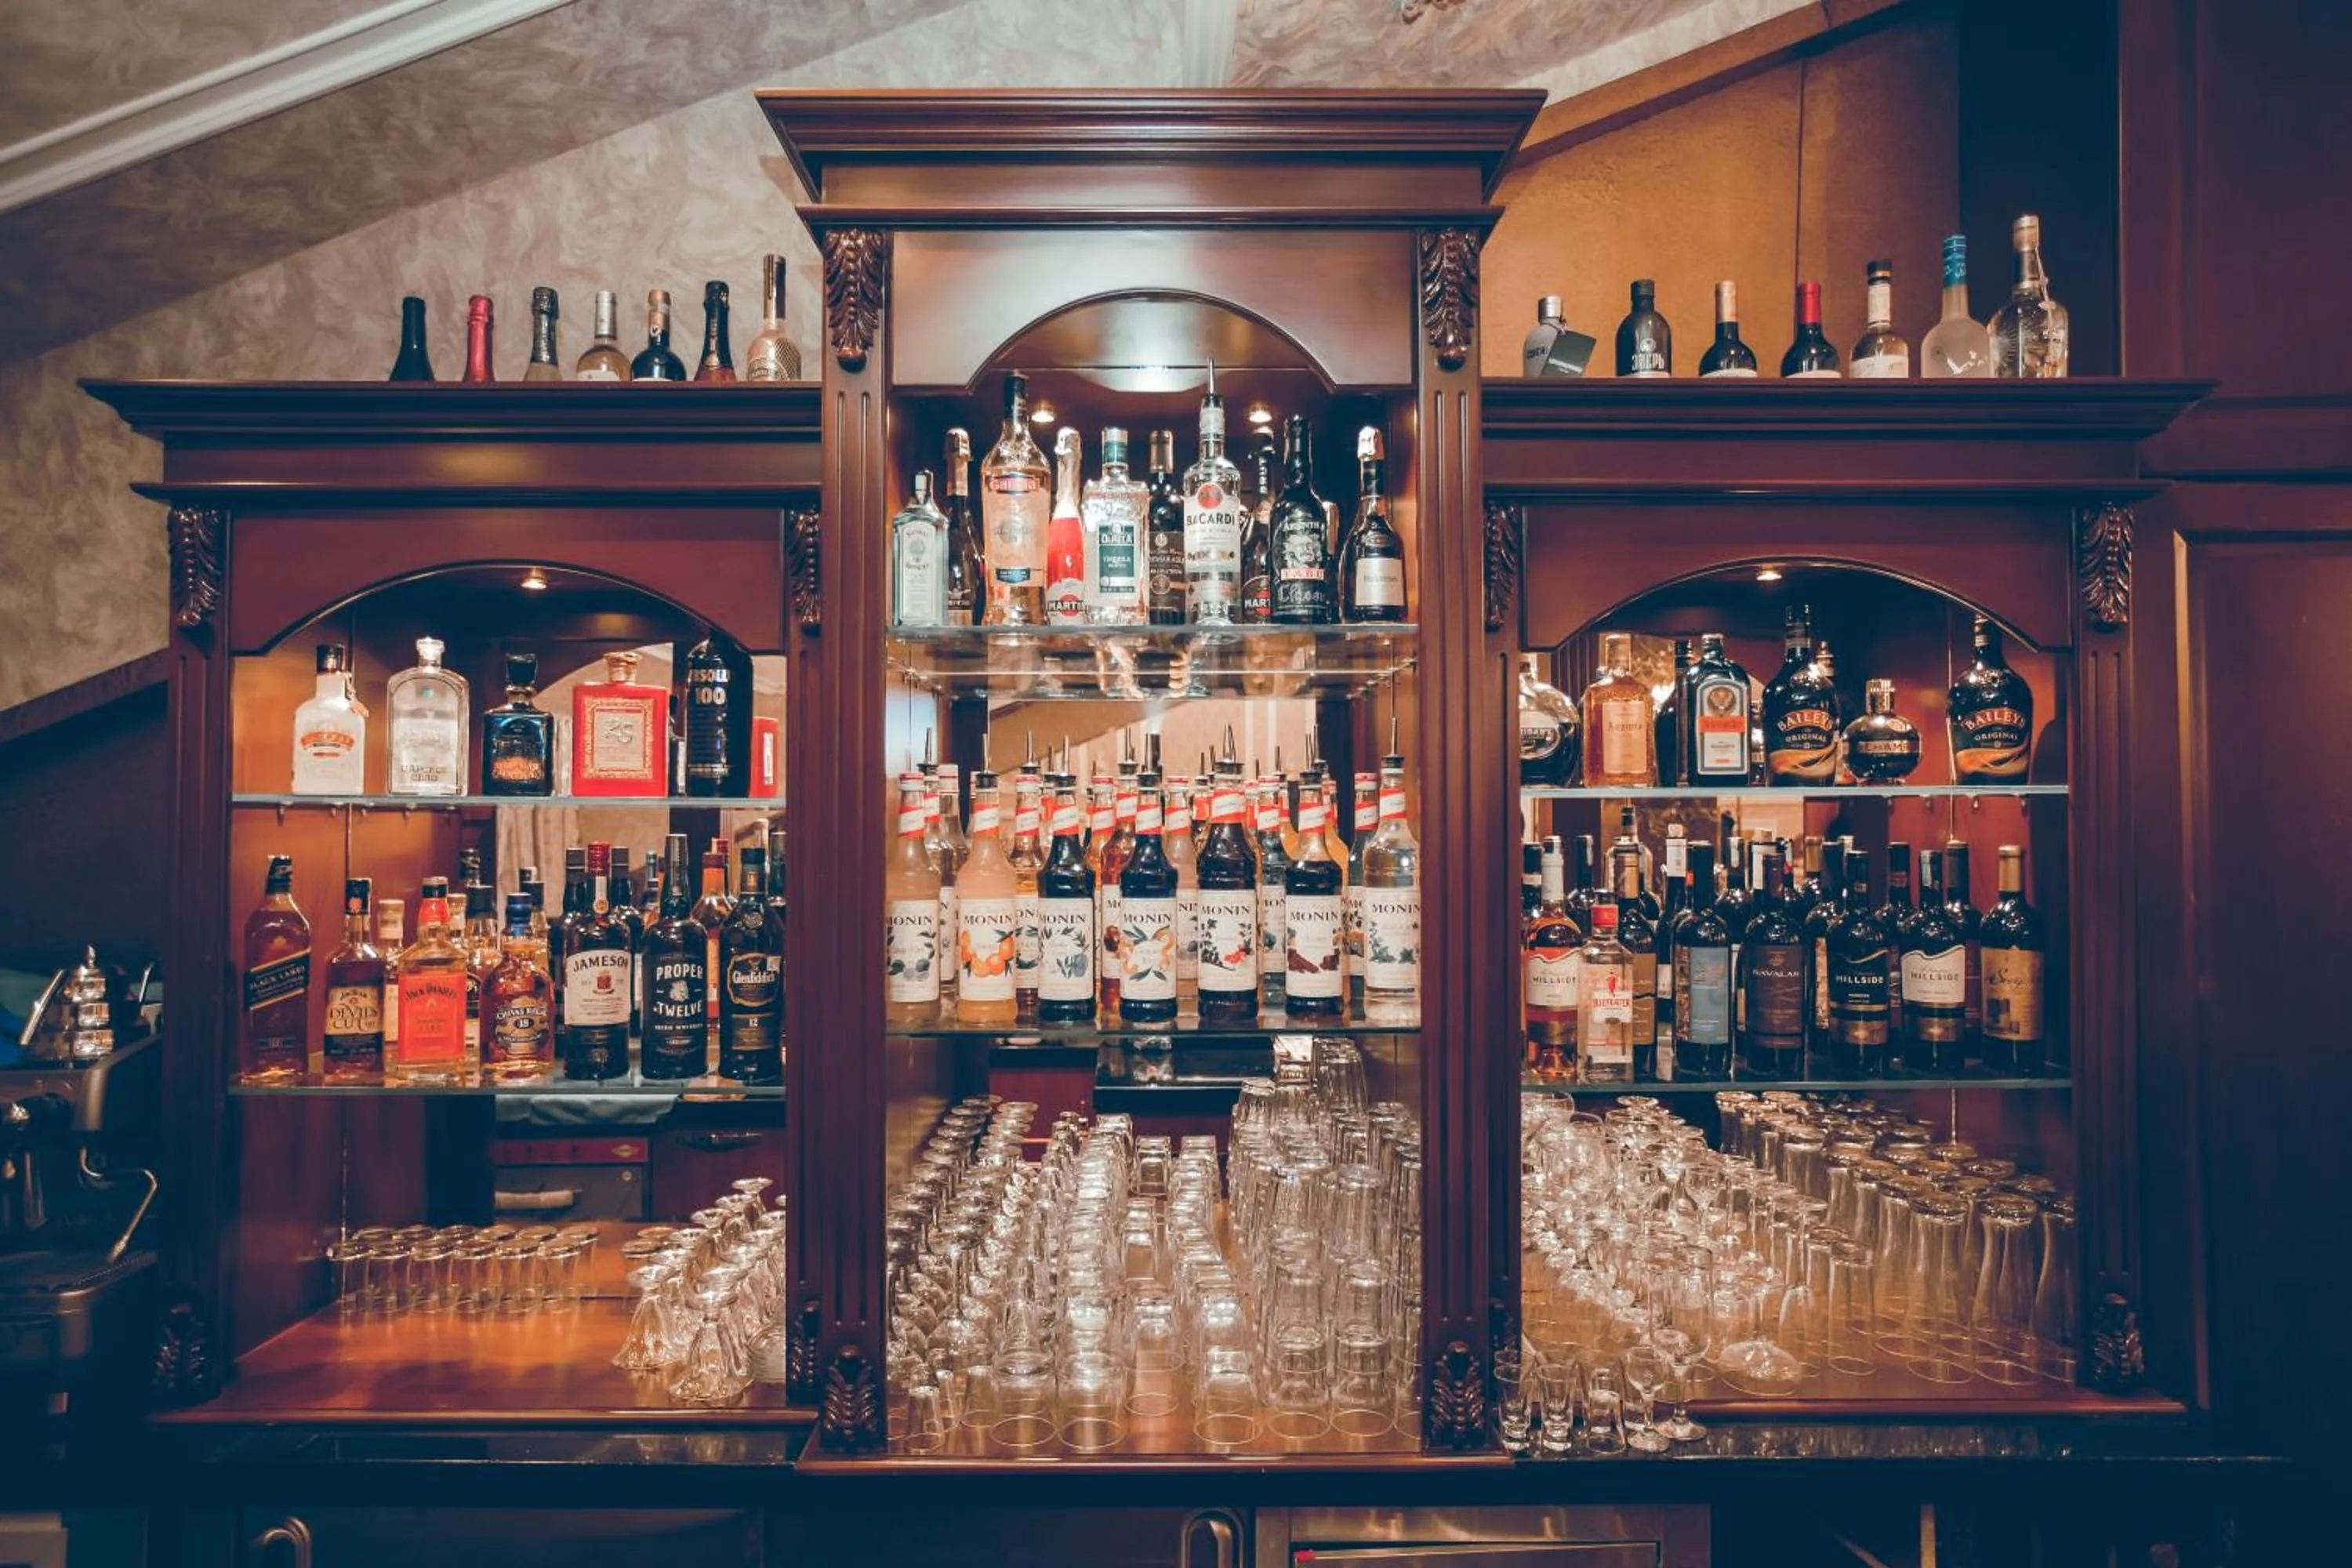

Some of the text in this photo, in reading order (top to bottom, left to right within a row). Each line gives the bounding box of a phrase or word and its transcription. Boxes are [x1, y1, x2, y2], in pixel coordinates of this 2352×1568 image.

[1258, 456, 1268, 494] BRUT
[695, 687, 726, 705] 100
[1777, 710, 1834, 731] BAILEYS
[1965, 710, 2026, 731] BAILEYS
[1785, 733, 1827, 742] ORIGINAL
[1974, 731, 2017, 741] ORIGINAL
[1202, 905, 1251, 916] MONIN
[964, 913, 1014, 925] MONIN
[1123, 912, 1172, 924] MONIN
[1290, 911, 1338, 923] MONIN
[1835, 974, 1885, 984] HILLSIDE
[656, 1000, 703, 1017] TWELVE
